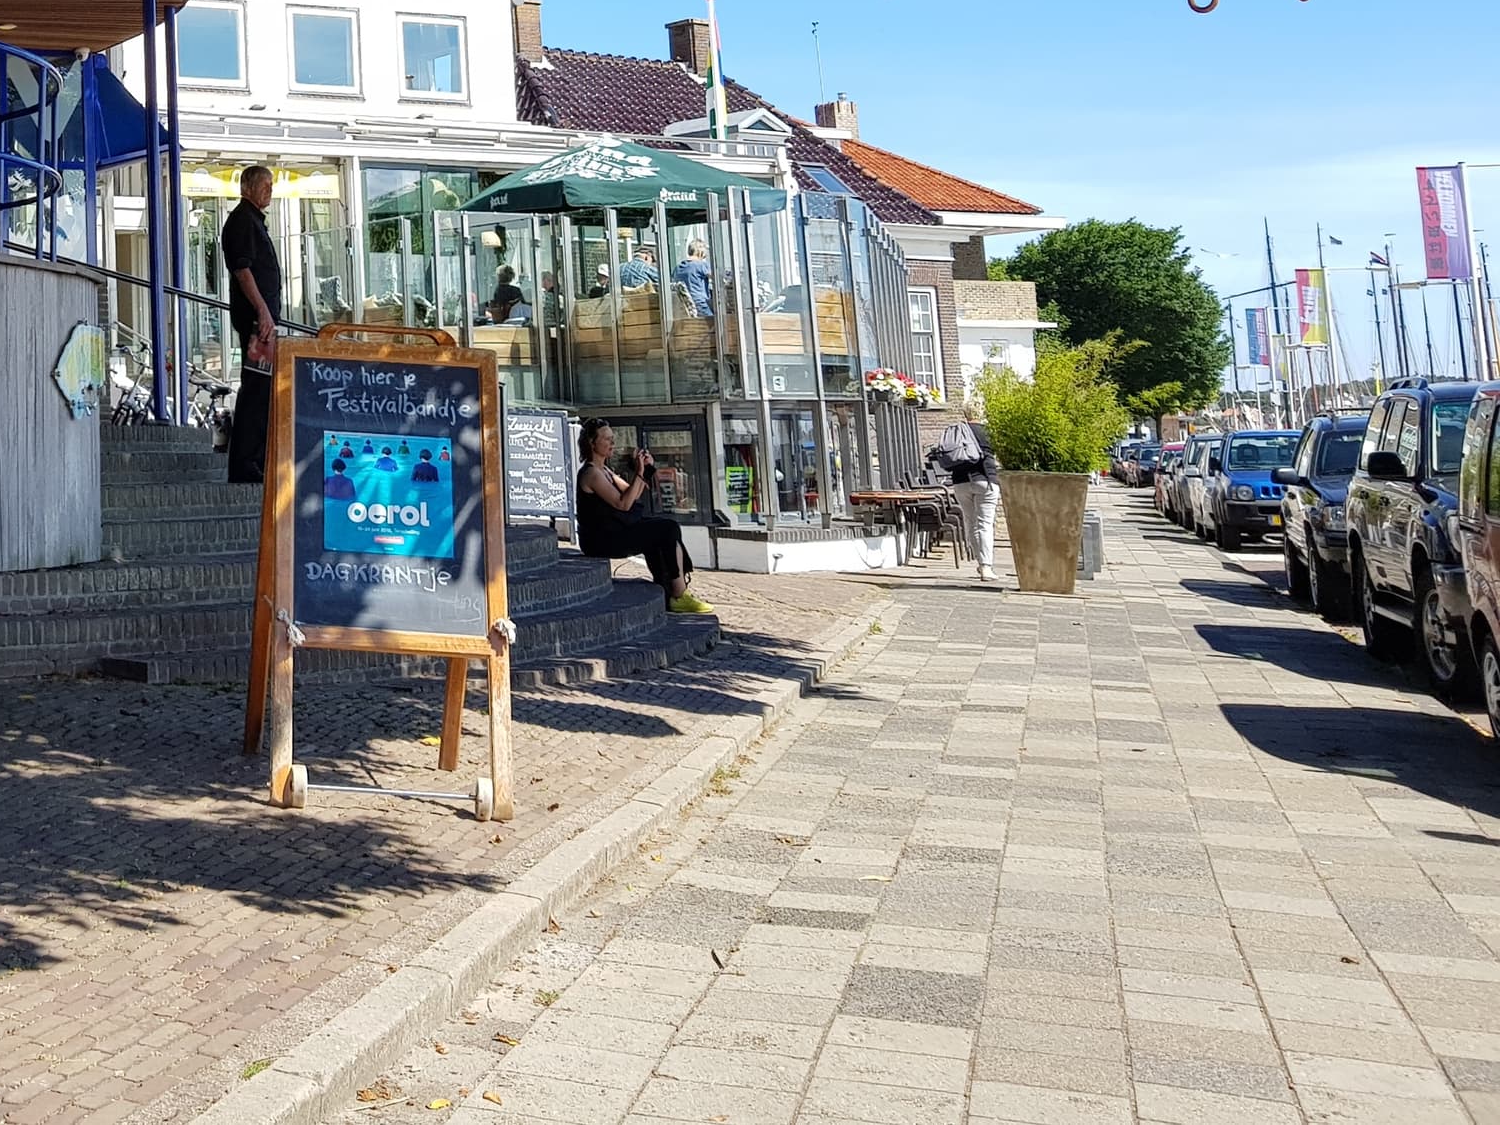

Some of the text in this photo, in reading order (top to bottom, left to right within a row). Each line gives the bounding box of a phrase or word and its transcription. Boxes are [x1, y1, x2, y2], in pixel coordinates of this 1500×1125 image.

[361, 366, 395, 386] hier
[395, 370, 417, 391] je
[318, 387, 473, 426] Festivalbandje
[347, 501, 430, 527] oerol
